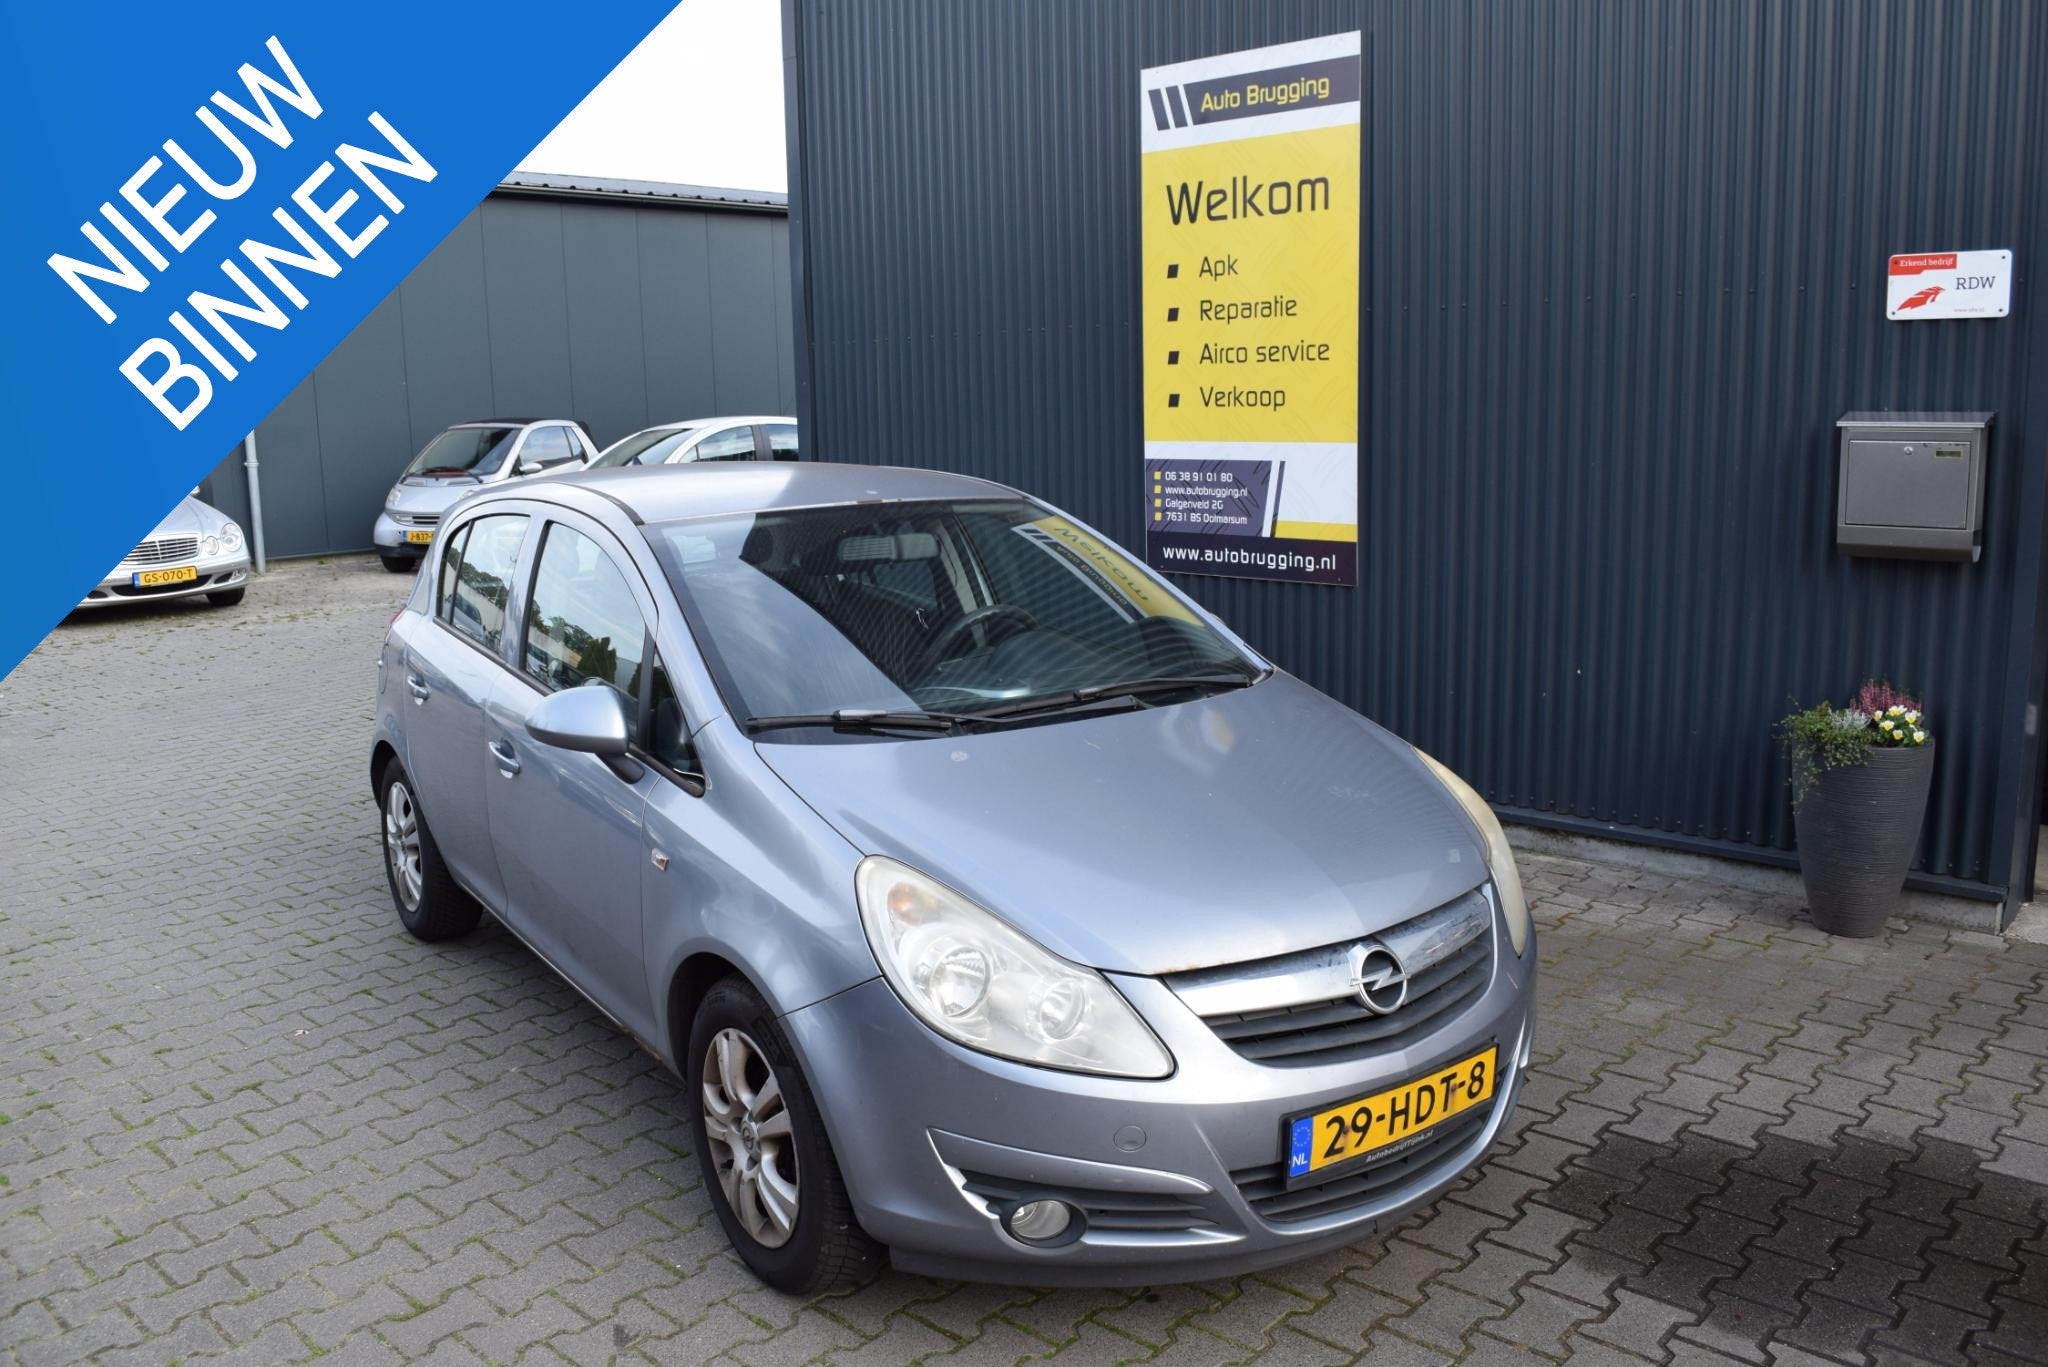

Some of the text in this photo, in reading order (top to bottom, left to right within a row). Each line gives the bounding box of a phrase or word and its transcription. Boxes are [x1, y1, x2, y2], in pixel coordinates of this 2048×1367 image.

[1200, 77, 1330, 113] Auto Brugging
[1166, 175, 1330, 226] Welkom
[1199, 254, 1239, 282] Apk
[1899, 257, 1954, 267] Erkend bedrijf
[1956, 276, 1996, 290] RDW
[1199, 295, 1298, 325] Reparatie
[1199, 340, 1330, 365] Airco service
[1199, 386, 1286, 412] Verkoop
[1165, 471, 1233, 482] 06 38 91 01 80
[1165, 486, 1248, 498] www.autobrugging.nl
[1166, 511, 1187, 521] 7631
[1190, 513, 1202, 522] BS
[1163, 547, 1337, 572] www.autobrugging.nl
[144, 568, 193, 584] GS-070-T
[1323, 1060, 1486, 1159] 29-HDT-8
[1291, 1153, 1308, 1166] NL
